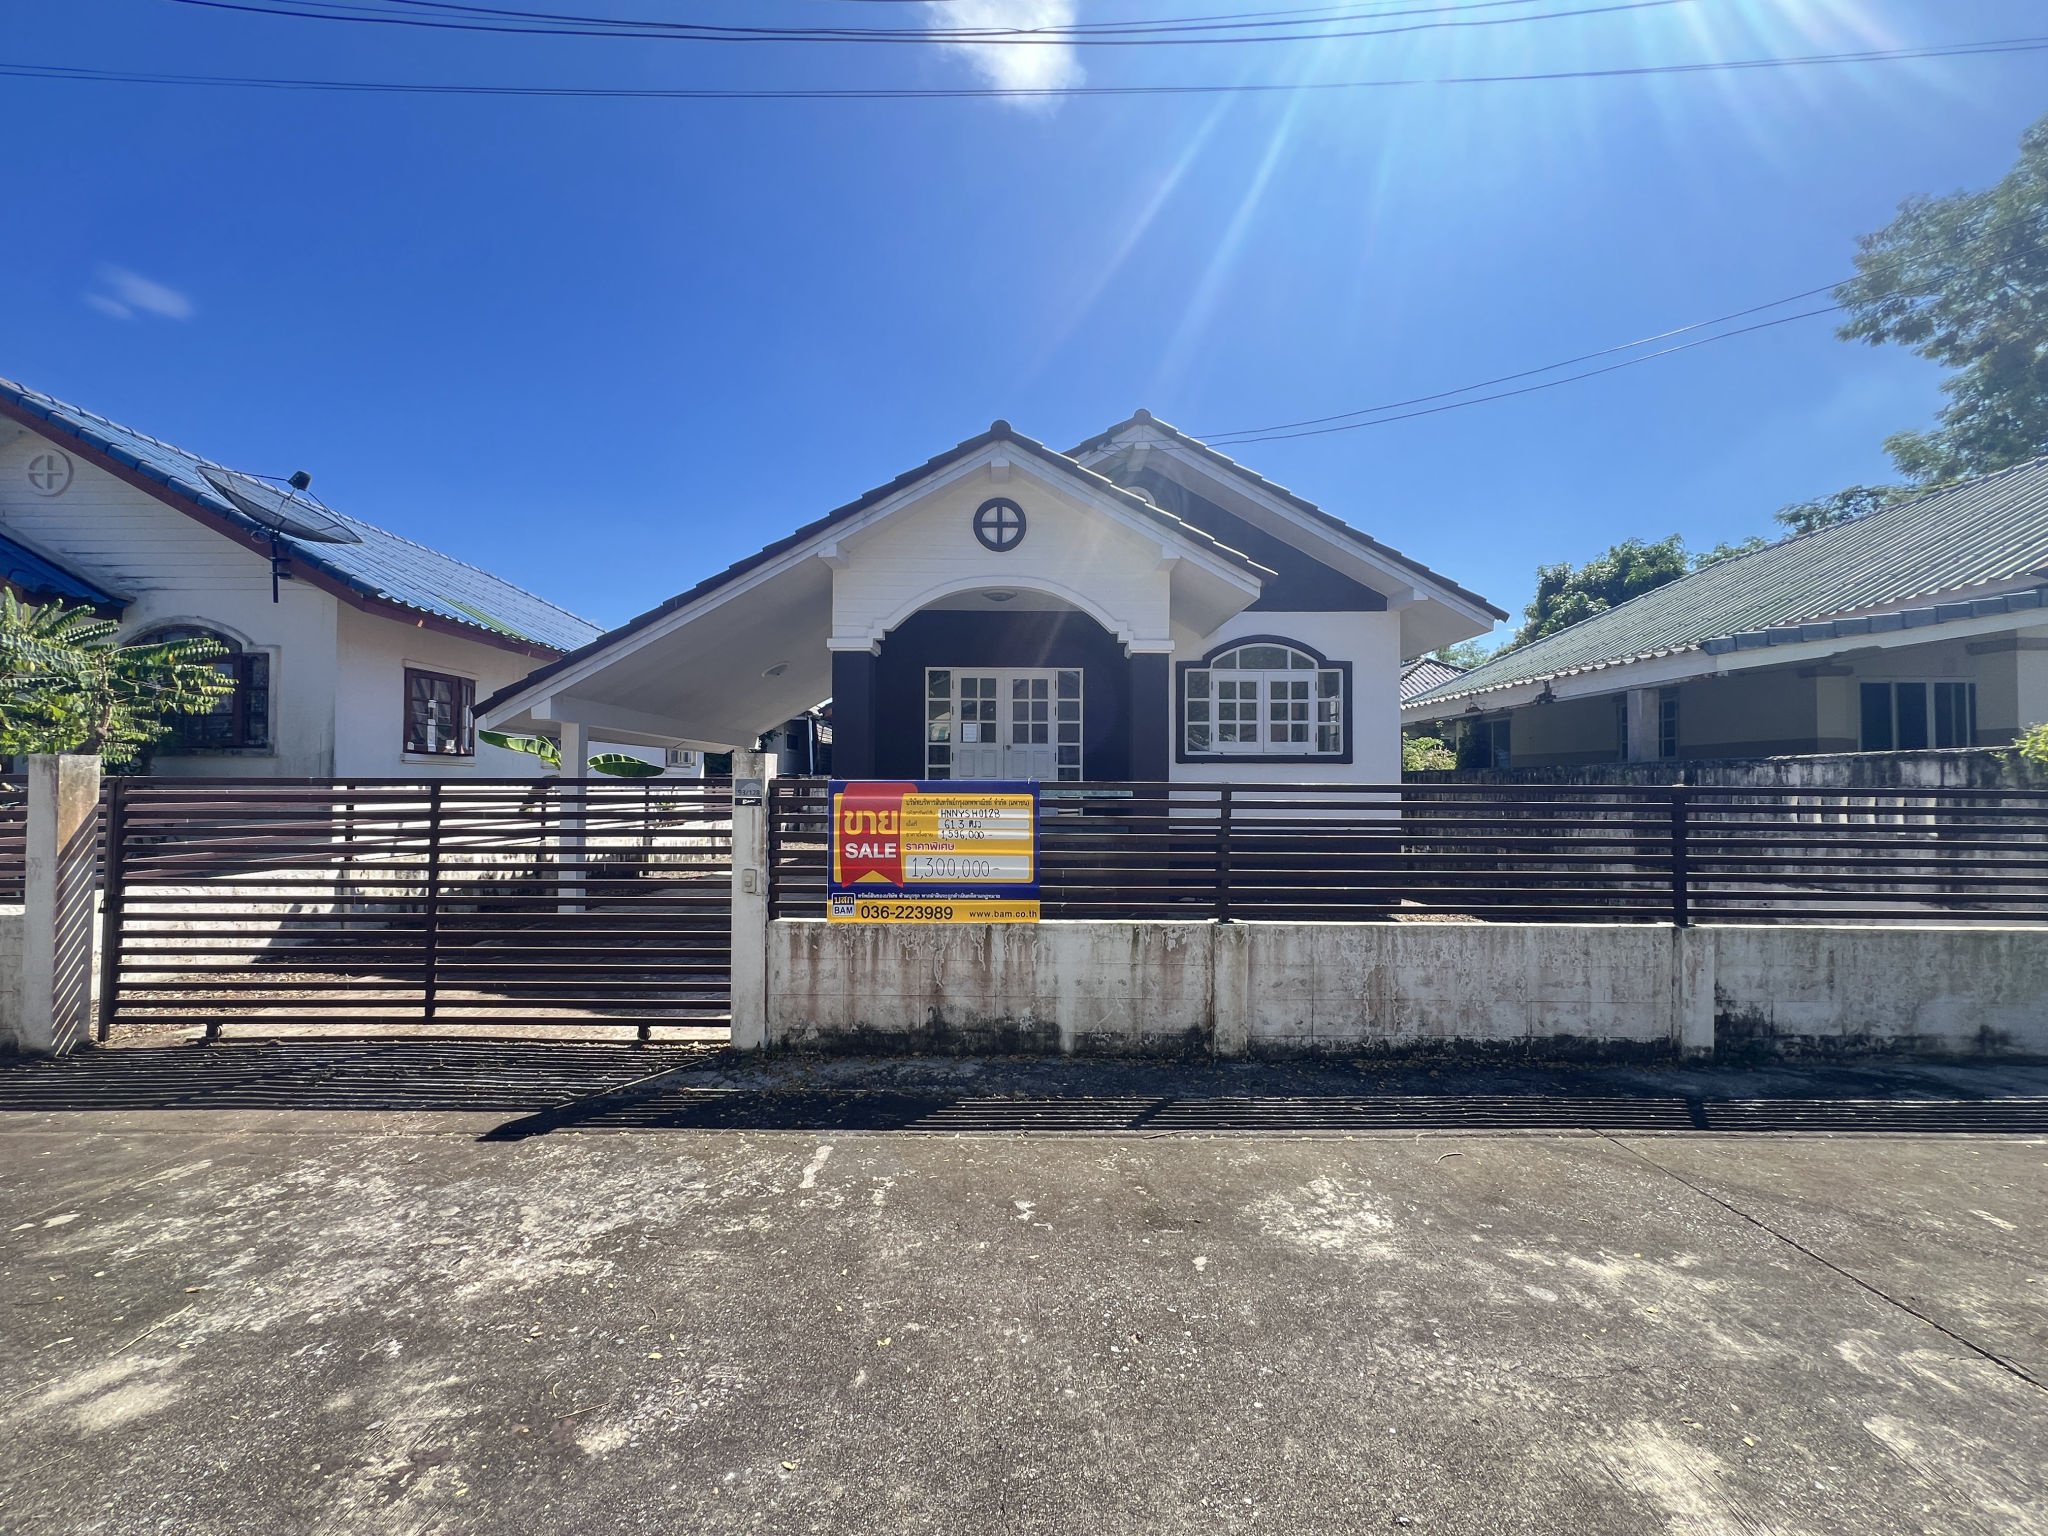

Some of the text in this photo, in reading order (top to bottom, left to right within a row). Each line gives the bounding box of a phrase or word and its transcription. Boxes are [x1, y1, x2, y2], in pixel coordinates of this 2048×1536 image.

[844, 810, 899, 835] ขาย
[845, 842, 897, 859] SALE
[905, 841, 955, 851] ราคาพิเศษ
[834, 906, 853, 914] BAM
[861, 905, 1037, 920] 036-223989 www.bam.co.th
